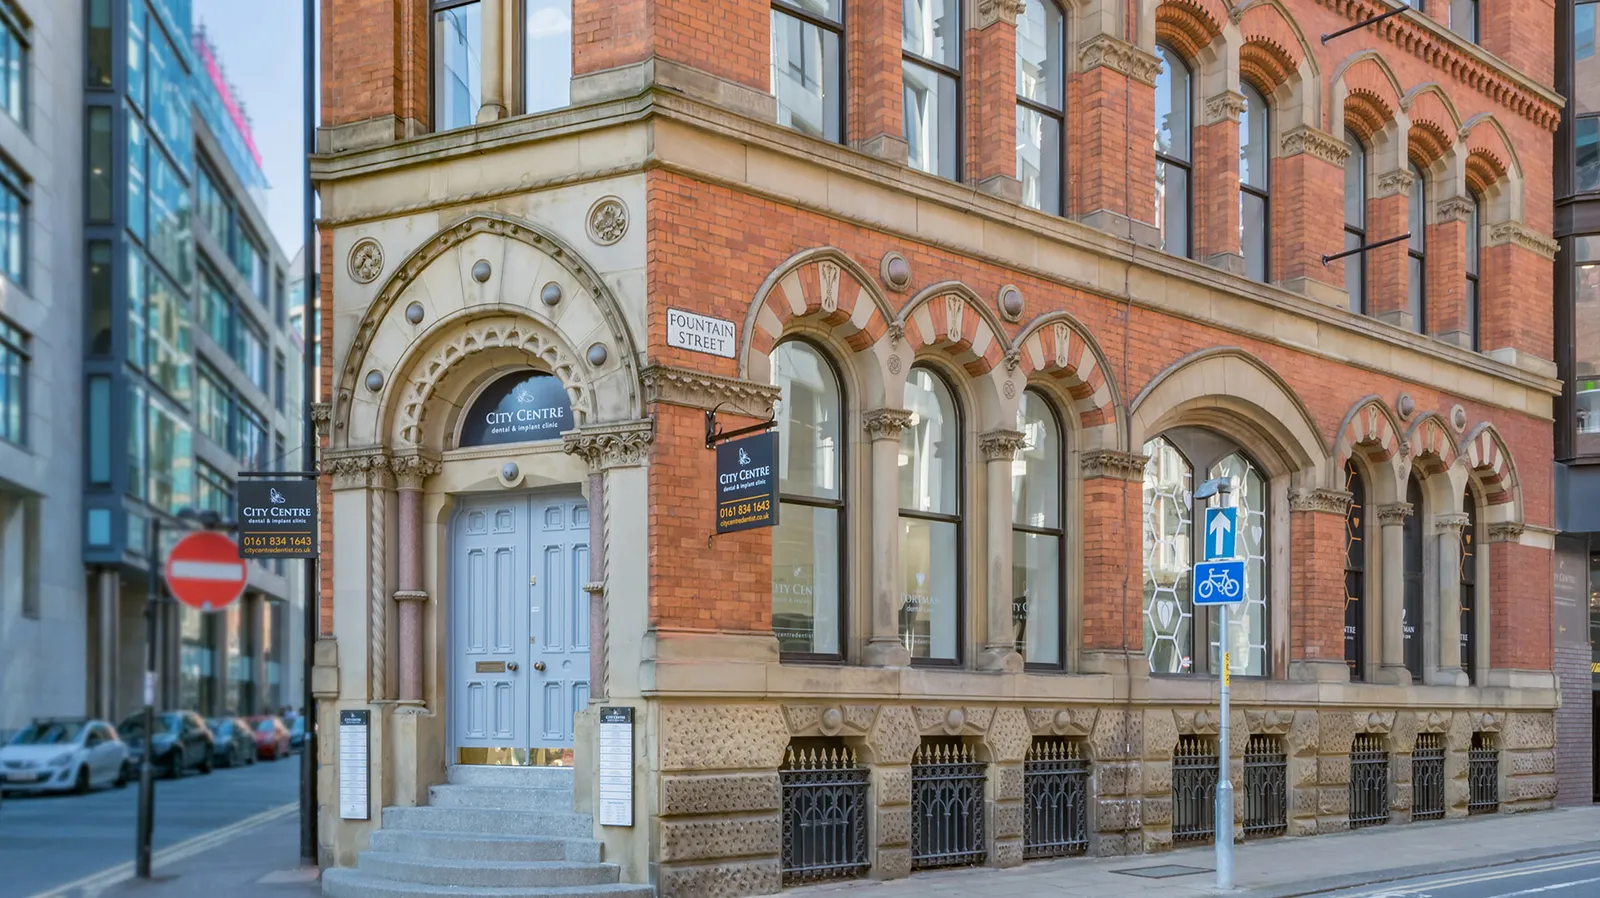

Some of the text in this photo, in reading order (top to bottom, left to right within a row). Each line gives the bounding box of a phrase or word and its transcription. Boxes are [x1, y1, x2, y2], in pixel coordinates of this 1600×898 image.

[670, 313, 734, 338] FOUNTAIN
[679, 331, 725, 351] STREET
[486, 407, 564, 425] CITY CENTRE
[491, 426, 510, 434] dental
[518, 423, 540, 432] implant
[720, 465, 770, 485] CITY CENTRE
[723, 485, 736, 493] dental
[740, 480, 755, 489] implant
[755, 478, 766, 486] clinic
[243, 507, 311, 517] CITY CENTRE
[720, 500, 770, 518] 0161 834 1643
[244, 537, 312, 546] 0161 834 1643
